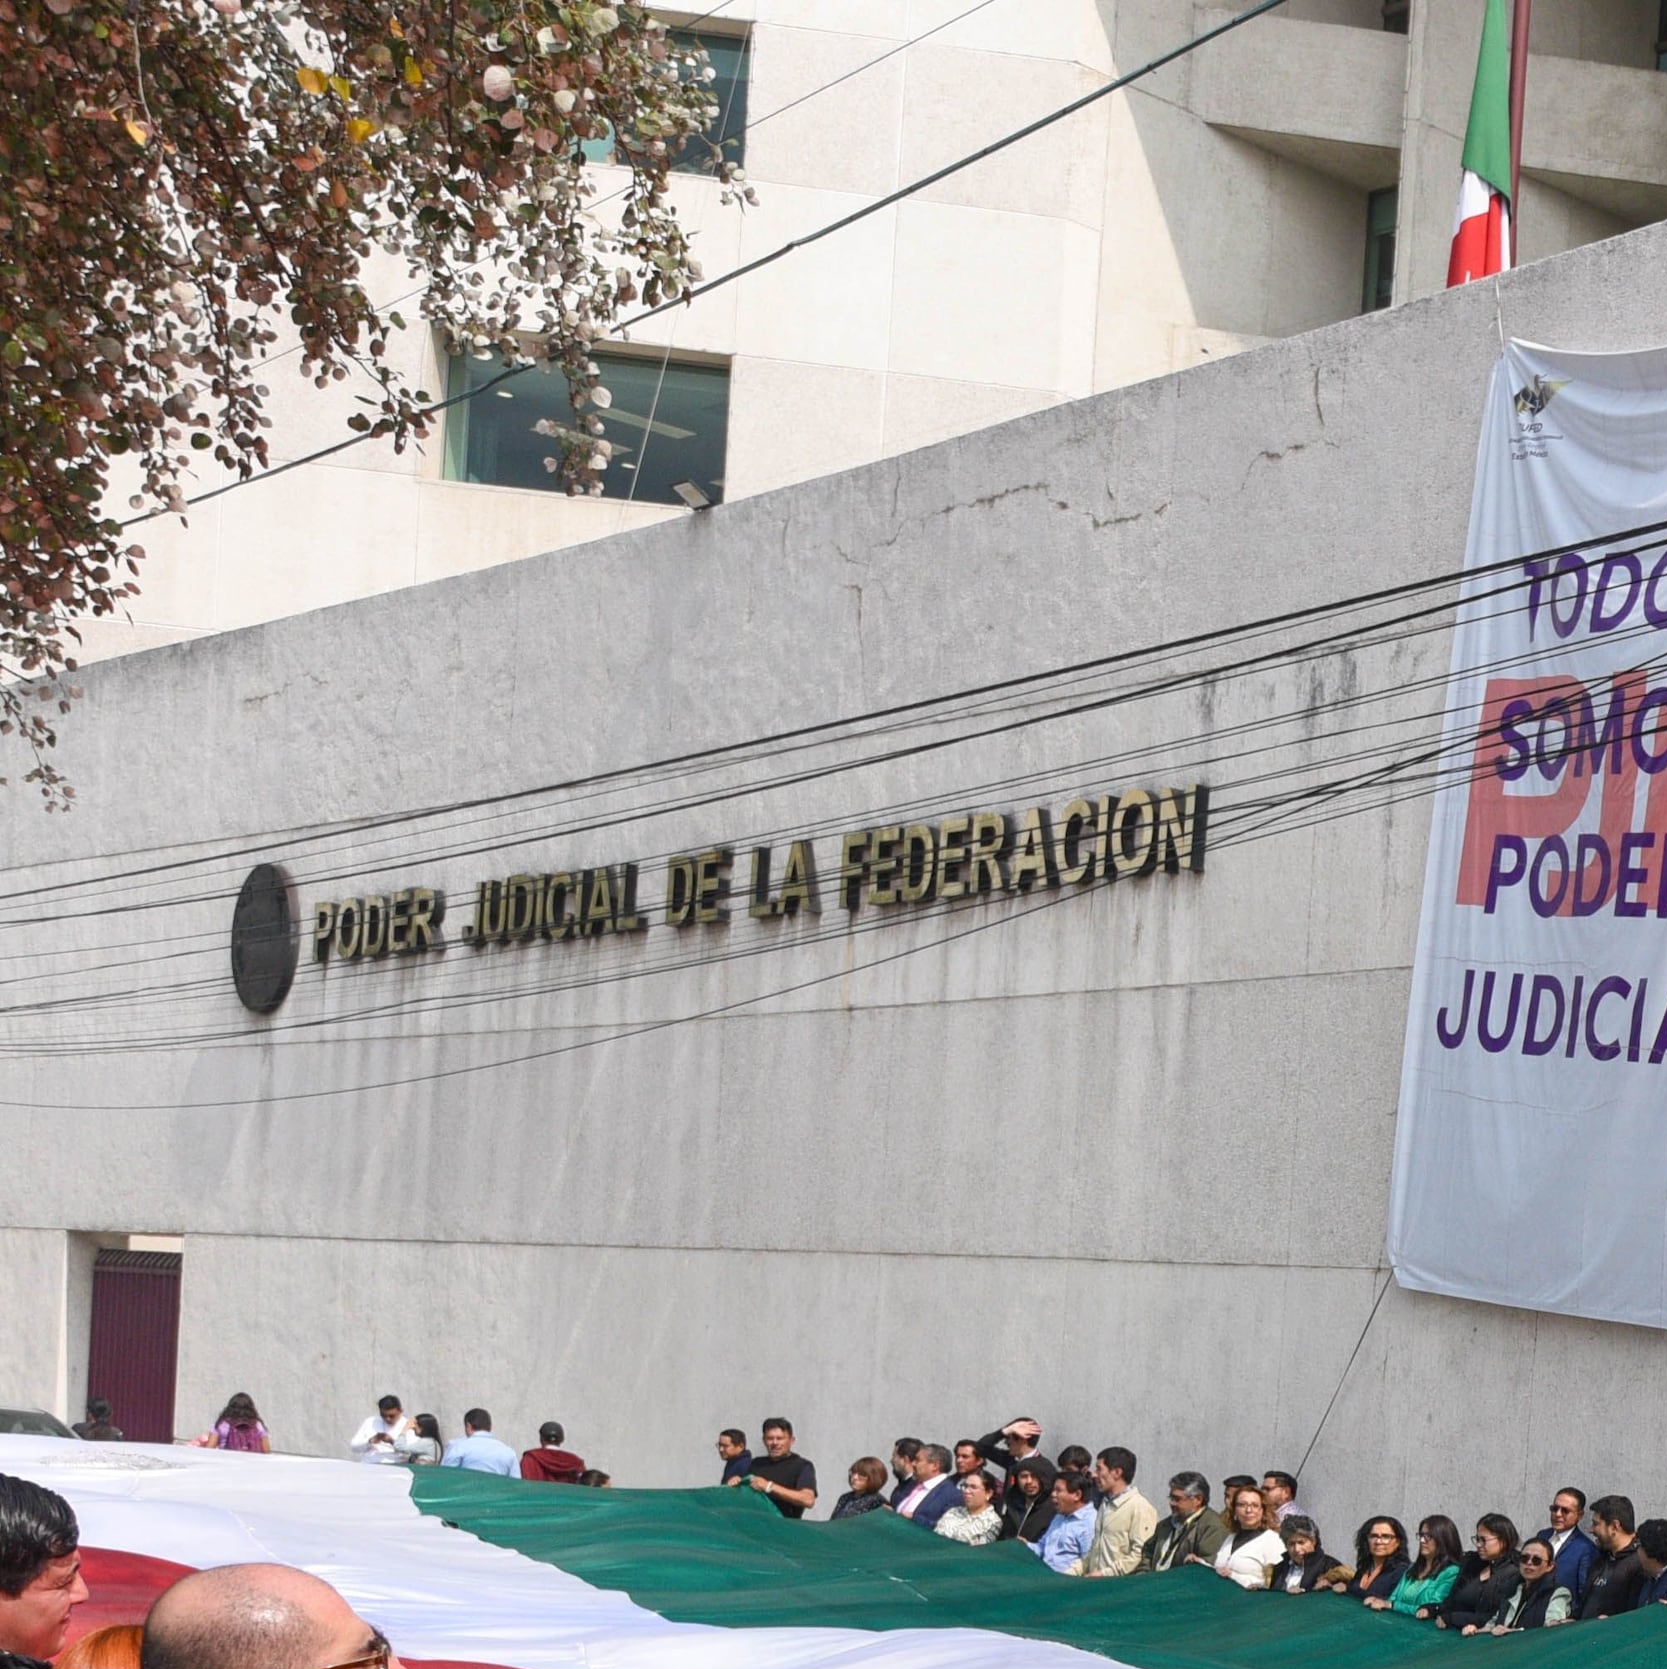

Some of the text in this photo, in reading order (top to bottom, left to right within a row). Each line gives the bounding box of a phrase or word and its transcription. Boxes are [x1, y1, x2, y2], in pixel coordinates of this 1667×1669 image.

[313, 784, 1211, 963] PODER JUDICIAL DE LA FEDERACION
